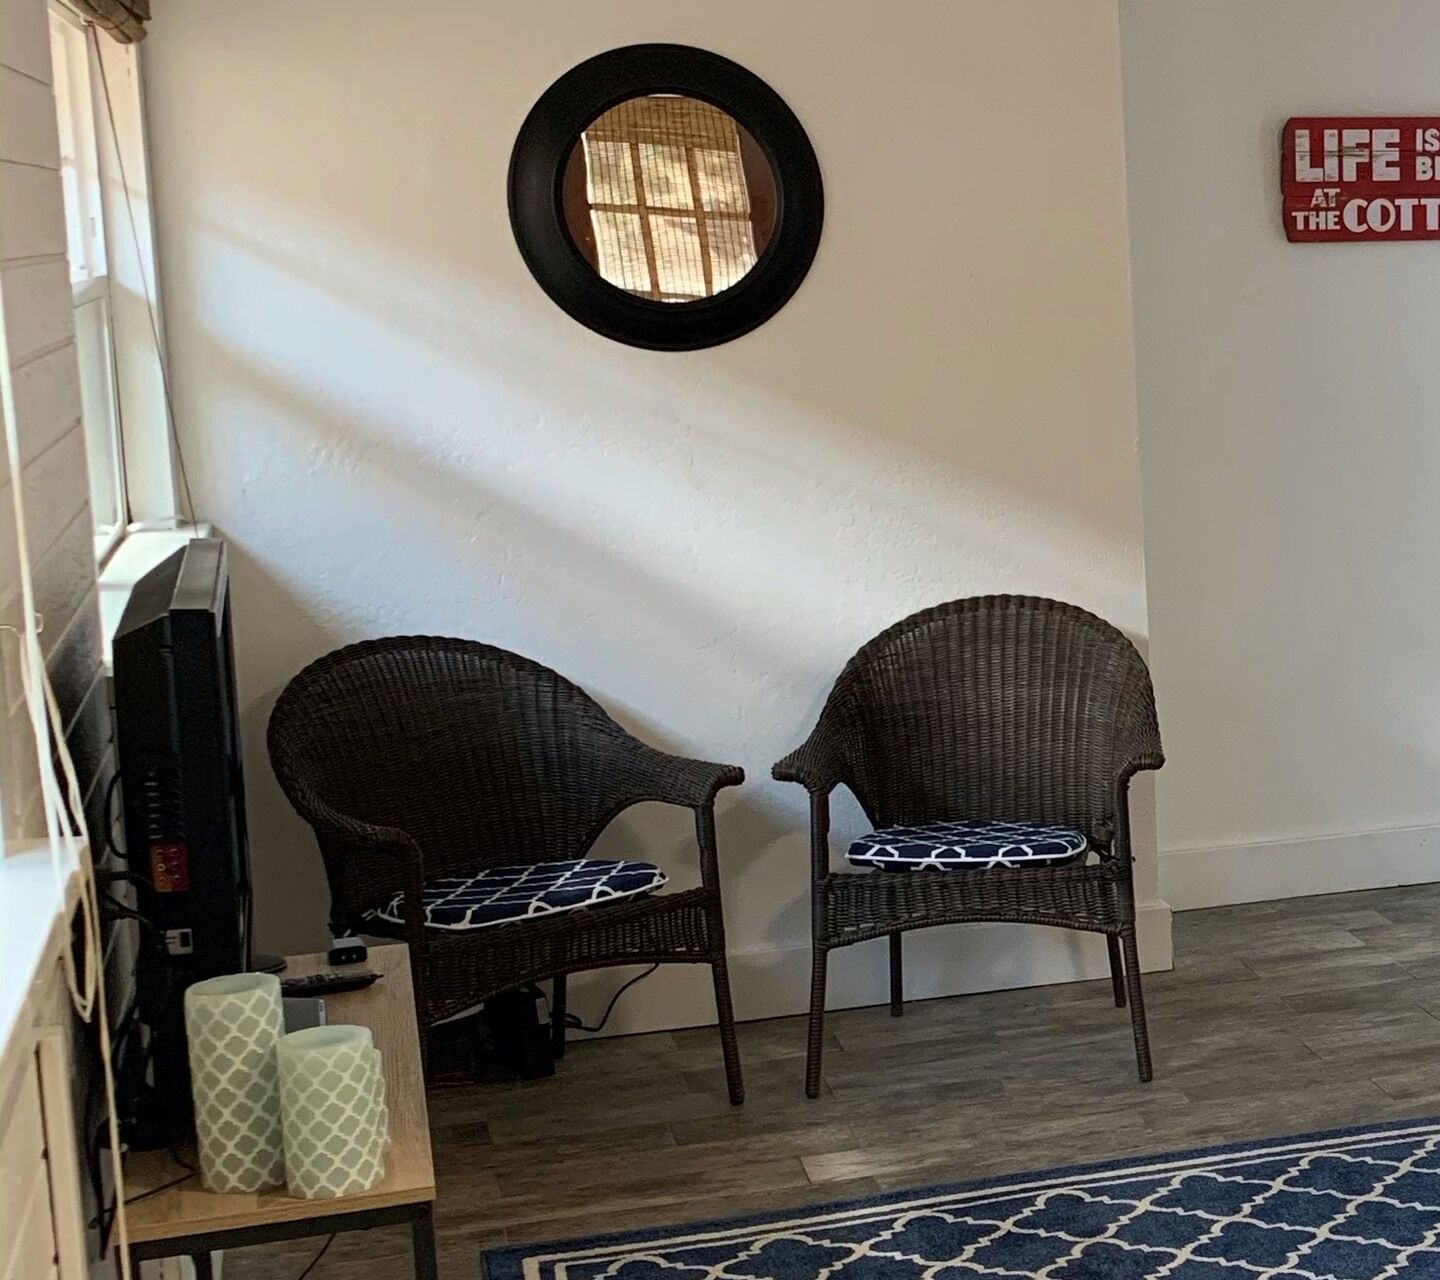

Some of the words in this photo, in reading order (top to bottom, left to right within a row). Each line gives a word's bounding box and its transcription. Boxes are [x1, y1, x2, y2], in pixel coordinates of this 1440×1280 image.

[1294, 128, 1401, 183] LIFE
[1415, 128, 1440, 153] IS
[1310, 188, 1341, 208] AT
[1291, 211, 1341, 231] THE
